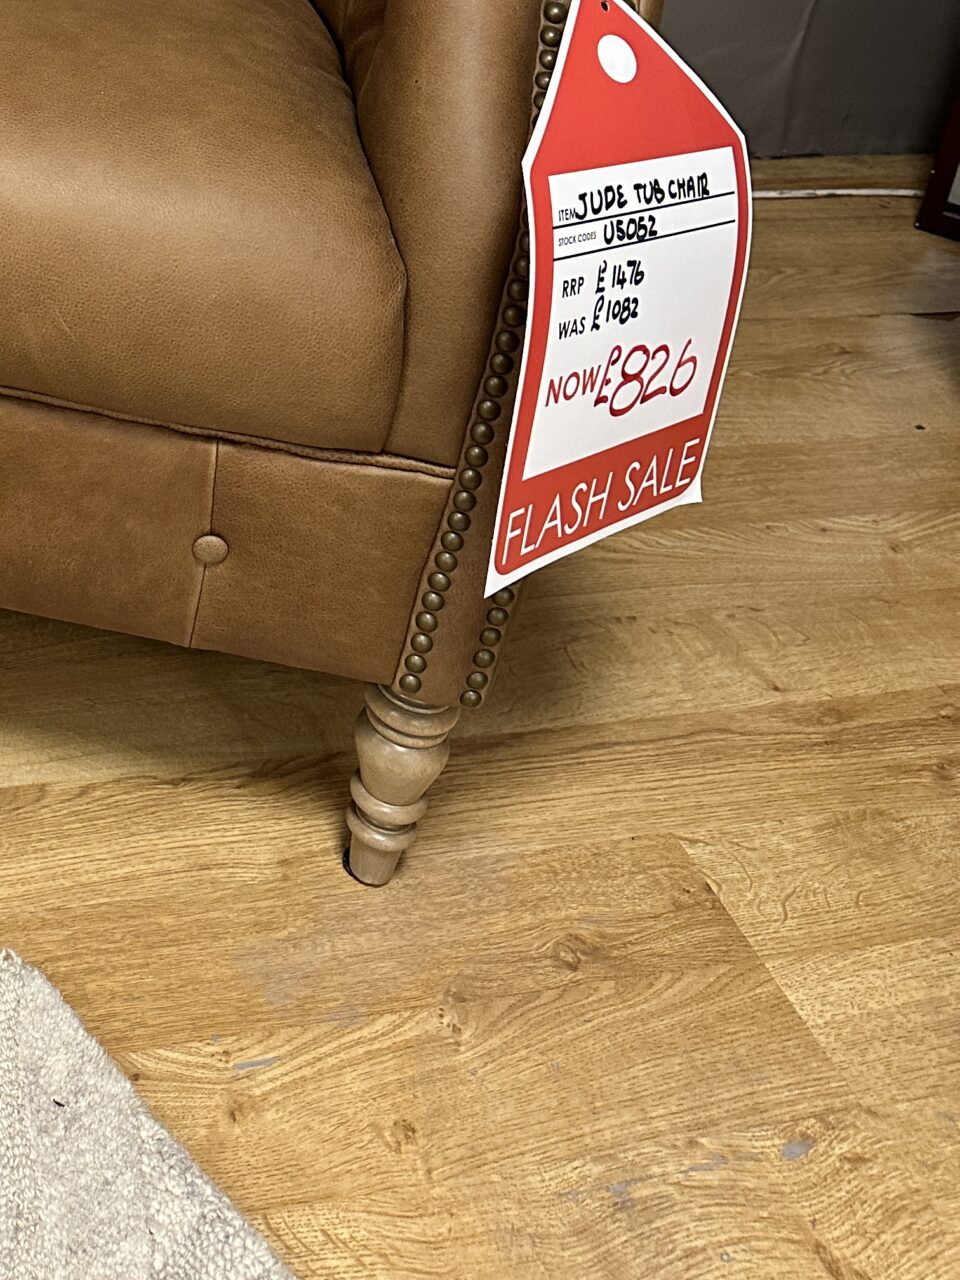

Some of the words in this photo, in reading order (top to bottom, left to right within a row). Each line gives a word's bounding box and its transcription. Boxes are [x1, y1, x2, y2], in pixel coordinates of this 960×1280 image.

[558, 207, 577, 222] ITEM
[575, 184, 628, 220] JUDE
[633, 178, 666, 205] TUB
[667, 172, 710, 199] CHAIR
[558, 235, 577, 247] STOCK
[577, 231, 597, 243] CODES
[561, 276, 585, 298] RRP
[558, 316, 586, 340] WAS
[590, 294, 639, 332] £1082
[545, 364, 602, 408] NOW
[593, 338, 698, 418] £826
[501, 471, 614, 566] FLASH
[616, 437, 701, 512] SALE
